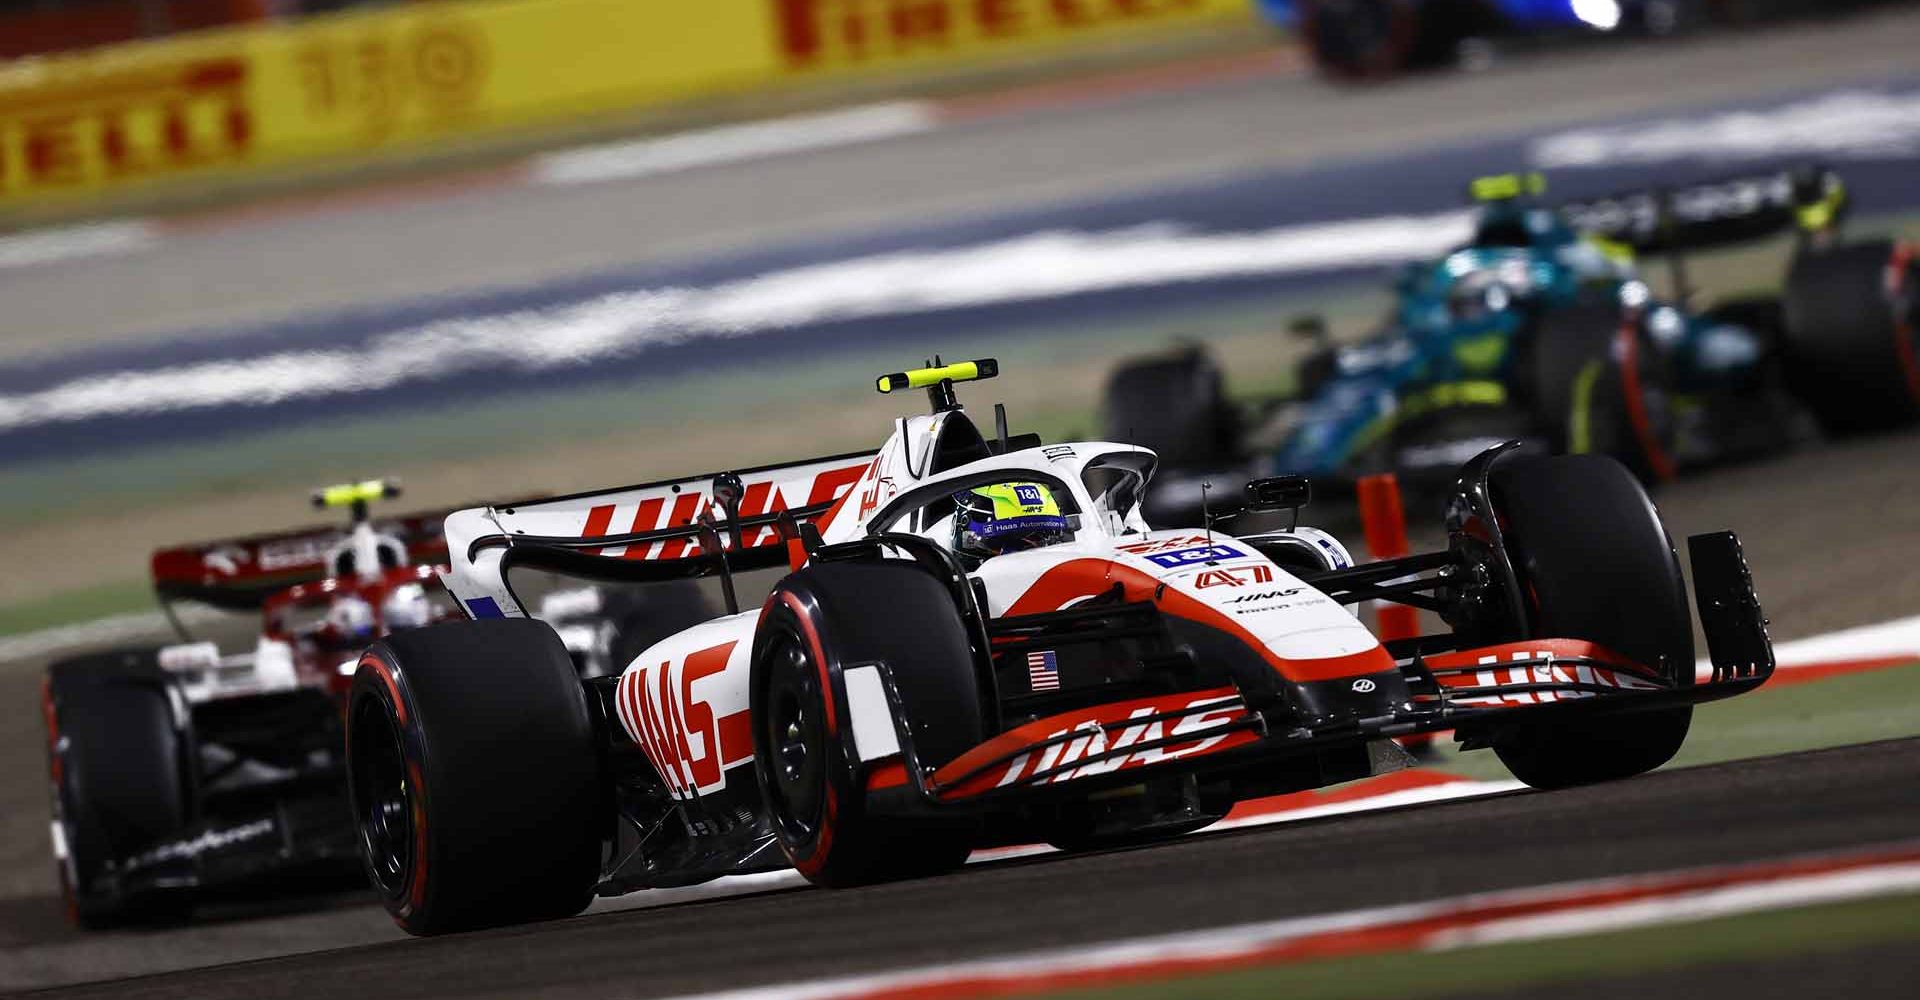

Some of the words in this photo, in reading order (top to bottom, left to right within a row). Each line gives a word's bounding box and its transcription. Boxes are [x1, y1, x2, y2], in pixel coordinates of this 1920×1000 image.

[0, 58, 252, 188] ELLI
[1017, 488, 1040, 500] 1&1
[996, 523, 1018, 532] Haas
[1020, 521, 1059, 529] Automation
[1156, 547, 1232, 564] 1&1
[1194, 565, 1273, 590] 47
[1222, 587, 1306, 605] HAAS
[619, 640, 755, 794] HAAS
[996, 695, 1243, 785] HAAS
